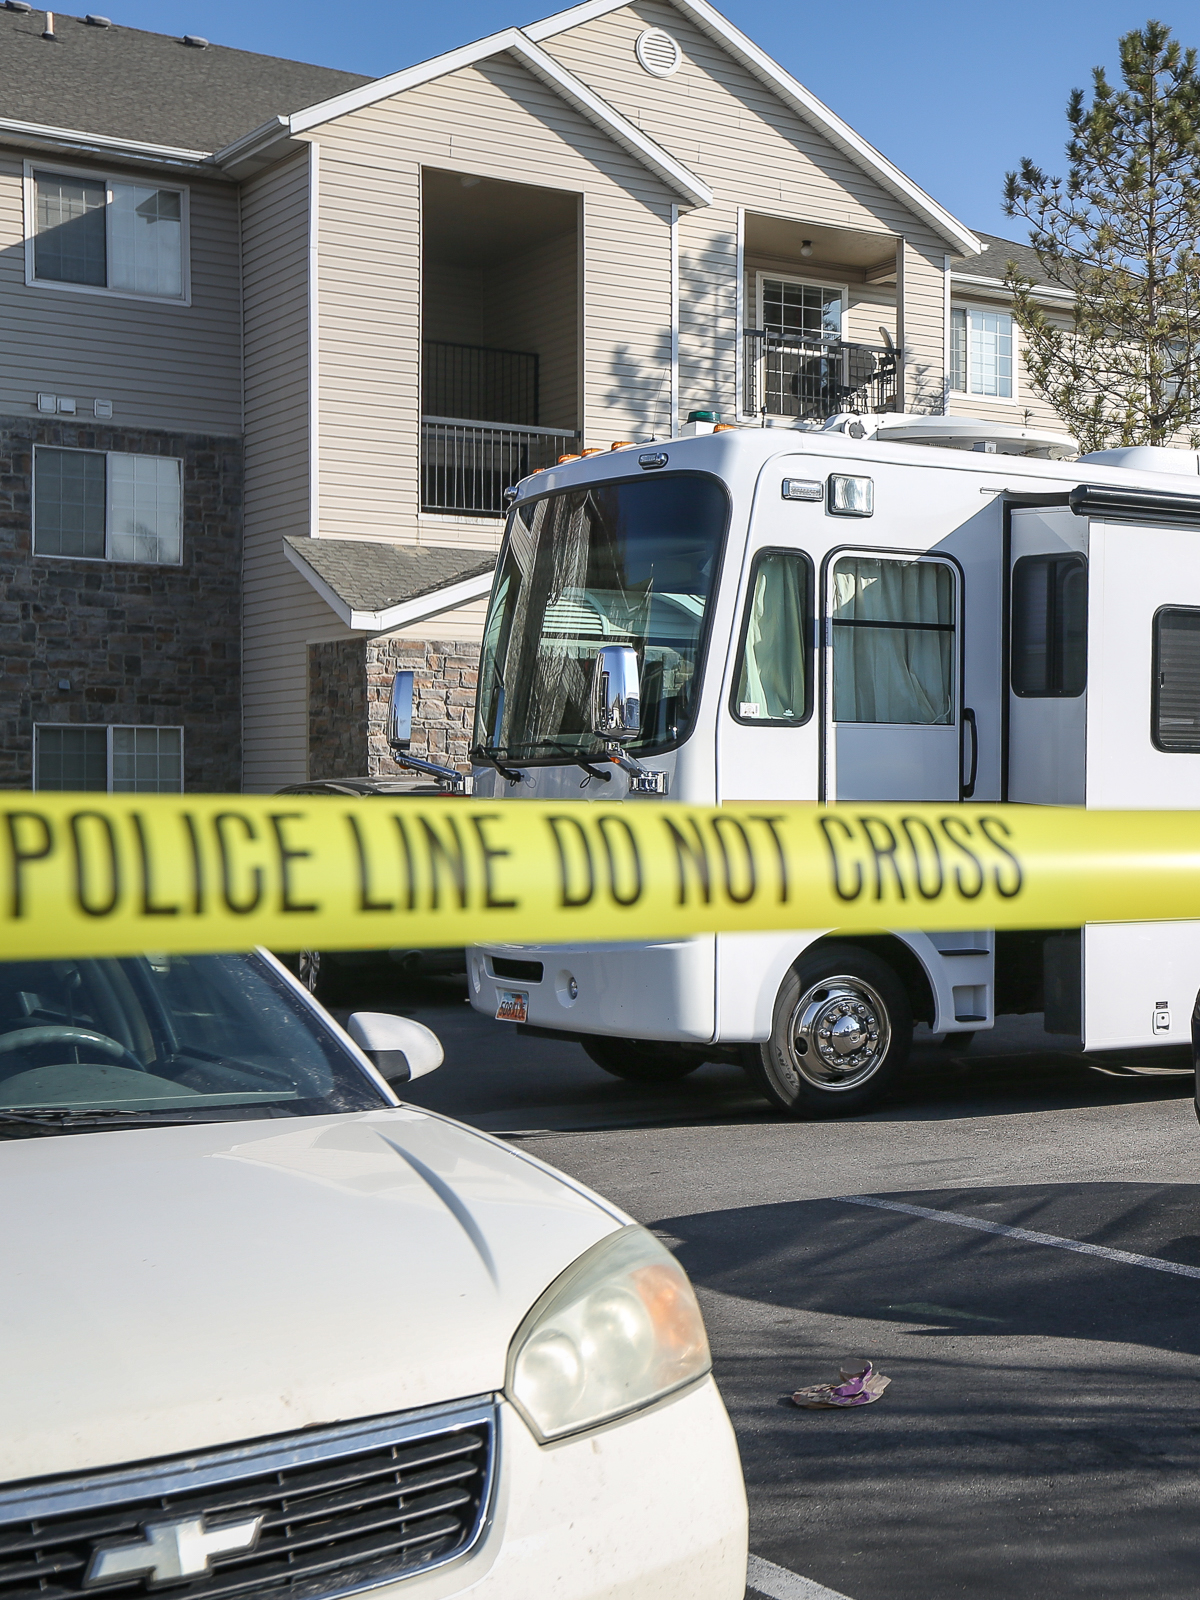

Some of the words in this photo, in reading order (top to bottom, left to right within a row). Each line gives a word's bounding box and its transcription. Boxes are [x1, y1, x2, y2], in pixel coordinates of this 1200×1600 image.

[4, 809, 321, 919] POLICE
[345, 813, 520, 912] LINE
[547, 814, 643, 908] DO
[663, 814, 790, 907] NOT
[819, 815, 1024, 902] CROSS
